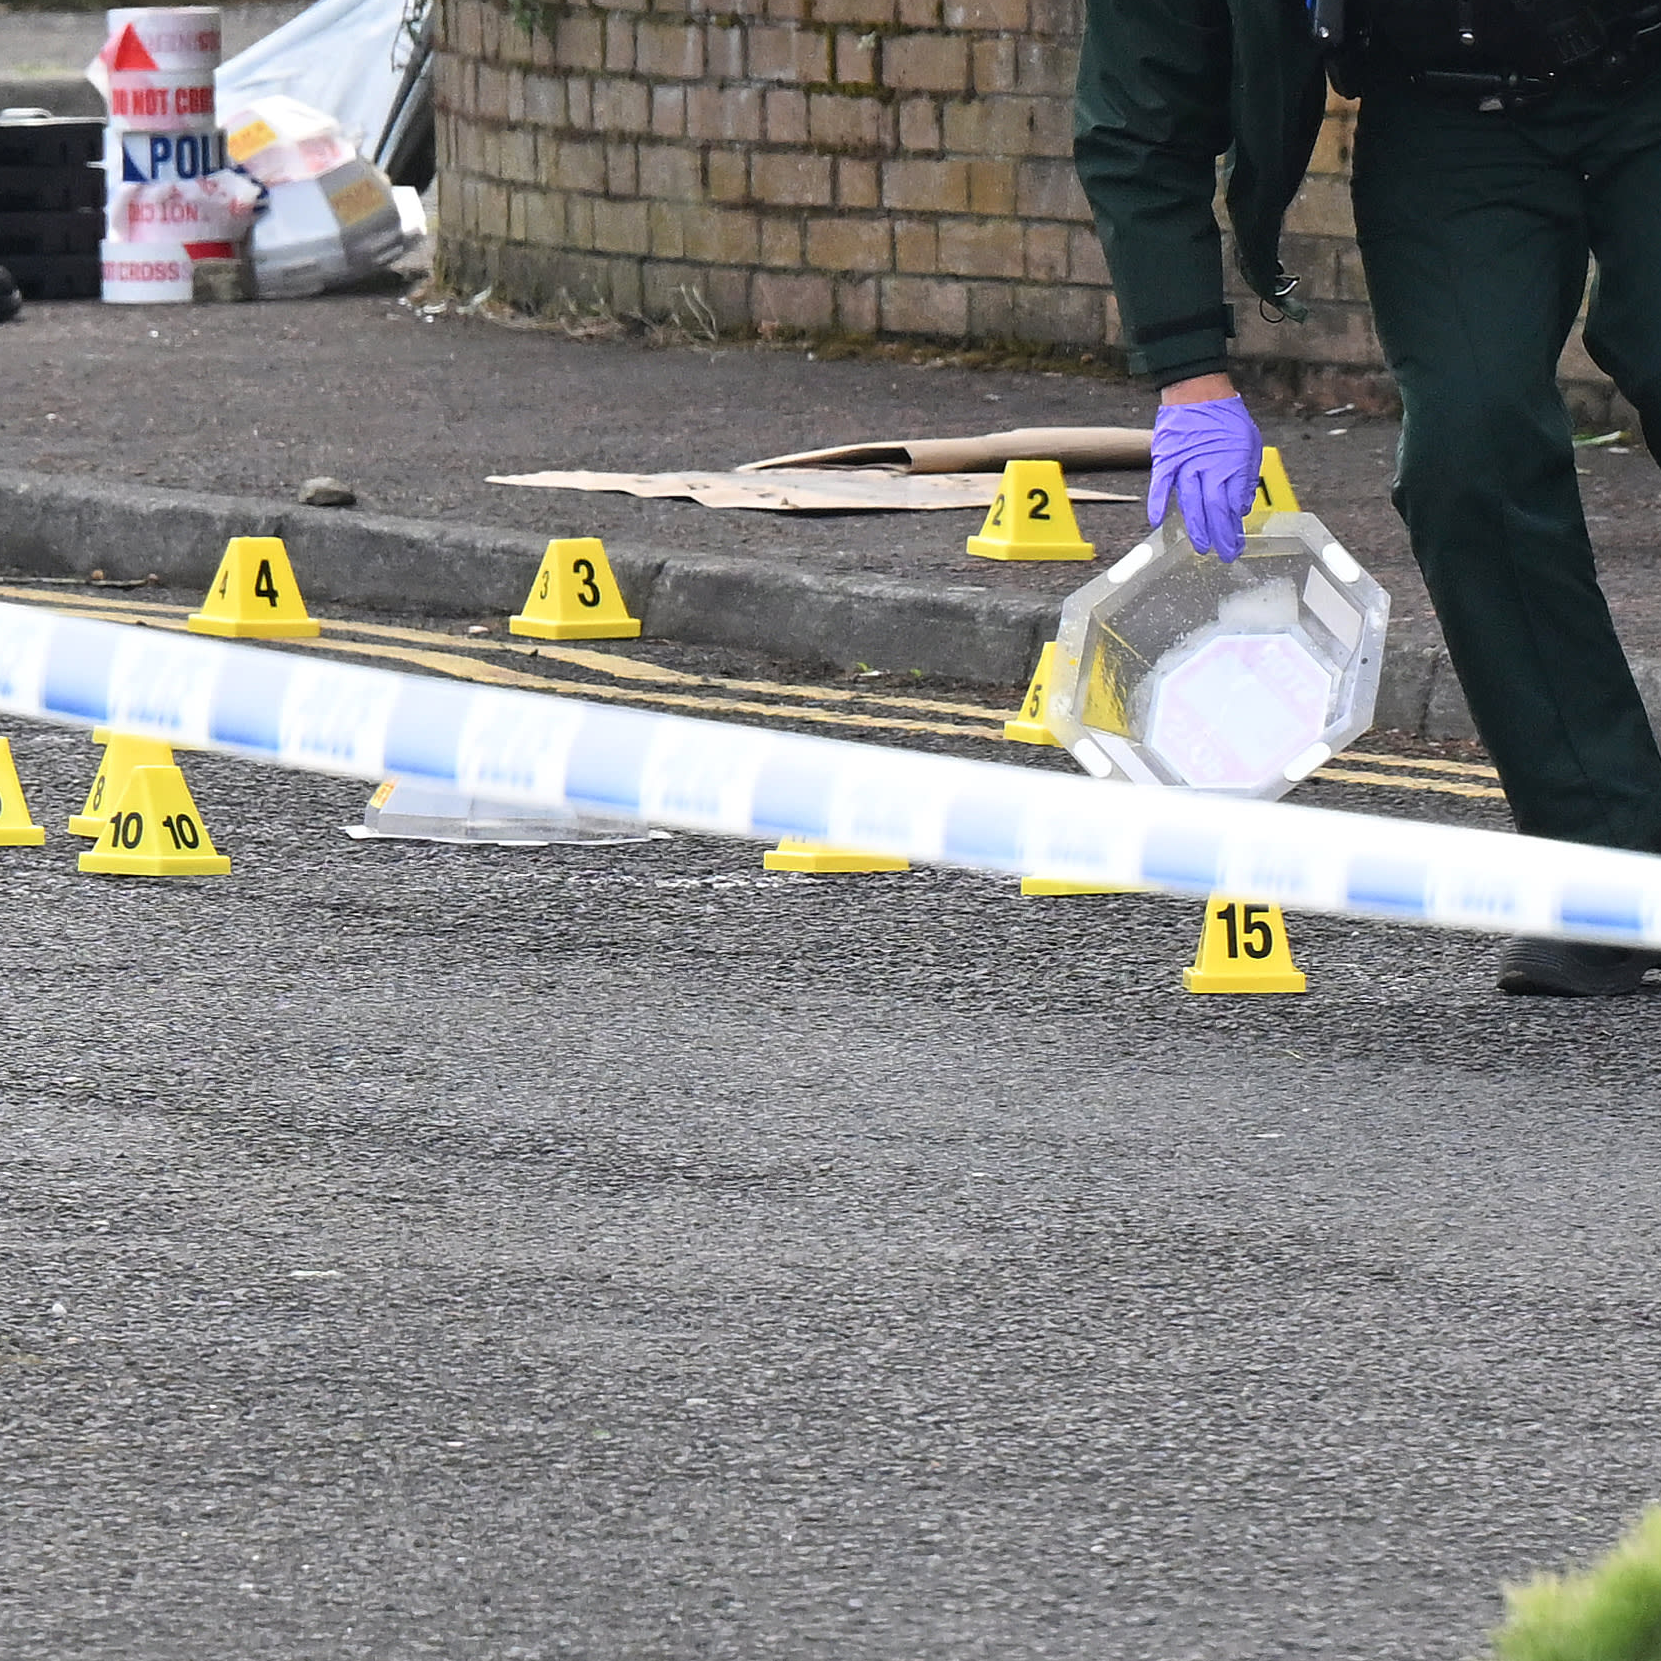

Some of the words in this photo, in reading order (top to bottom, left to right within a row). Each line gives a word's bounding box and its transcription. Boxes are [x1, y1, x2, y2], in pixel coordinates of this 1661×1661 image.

[133, 88, 168, 115] NOT
[992, 493, 1005, 526] 2
[1027, 488, 1051, 520] 2
[255, 559, 279, 607] 4
[540, 570, 550, 600] 3
[573, 558, 601, 607] 3
[1030, 684, 1043, 718] 5
[93, 775, 105, 811] 8
[110, 812, 143, 850] 10
[162, 813, 199, 850] 10
[1217, 903, 1273, 959] 15
